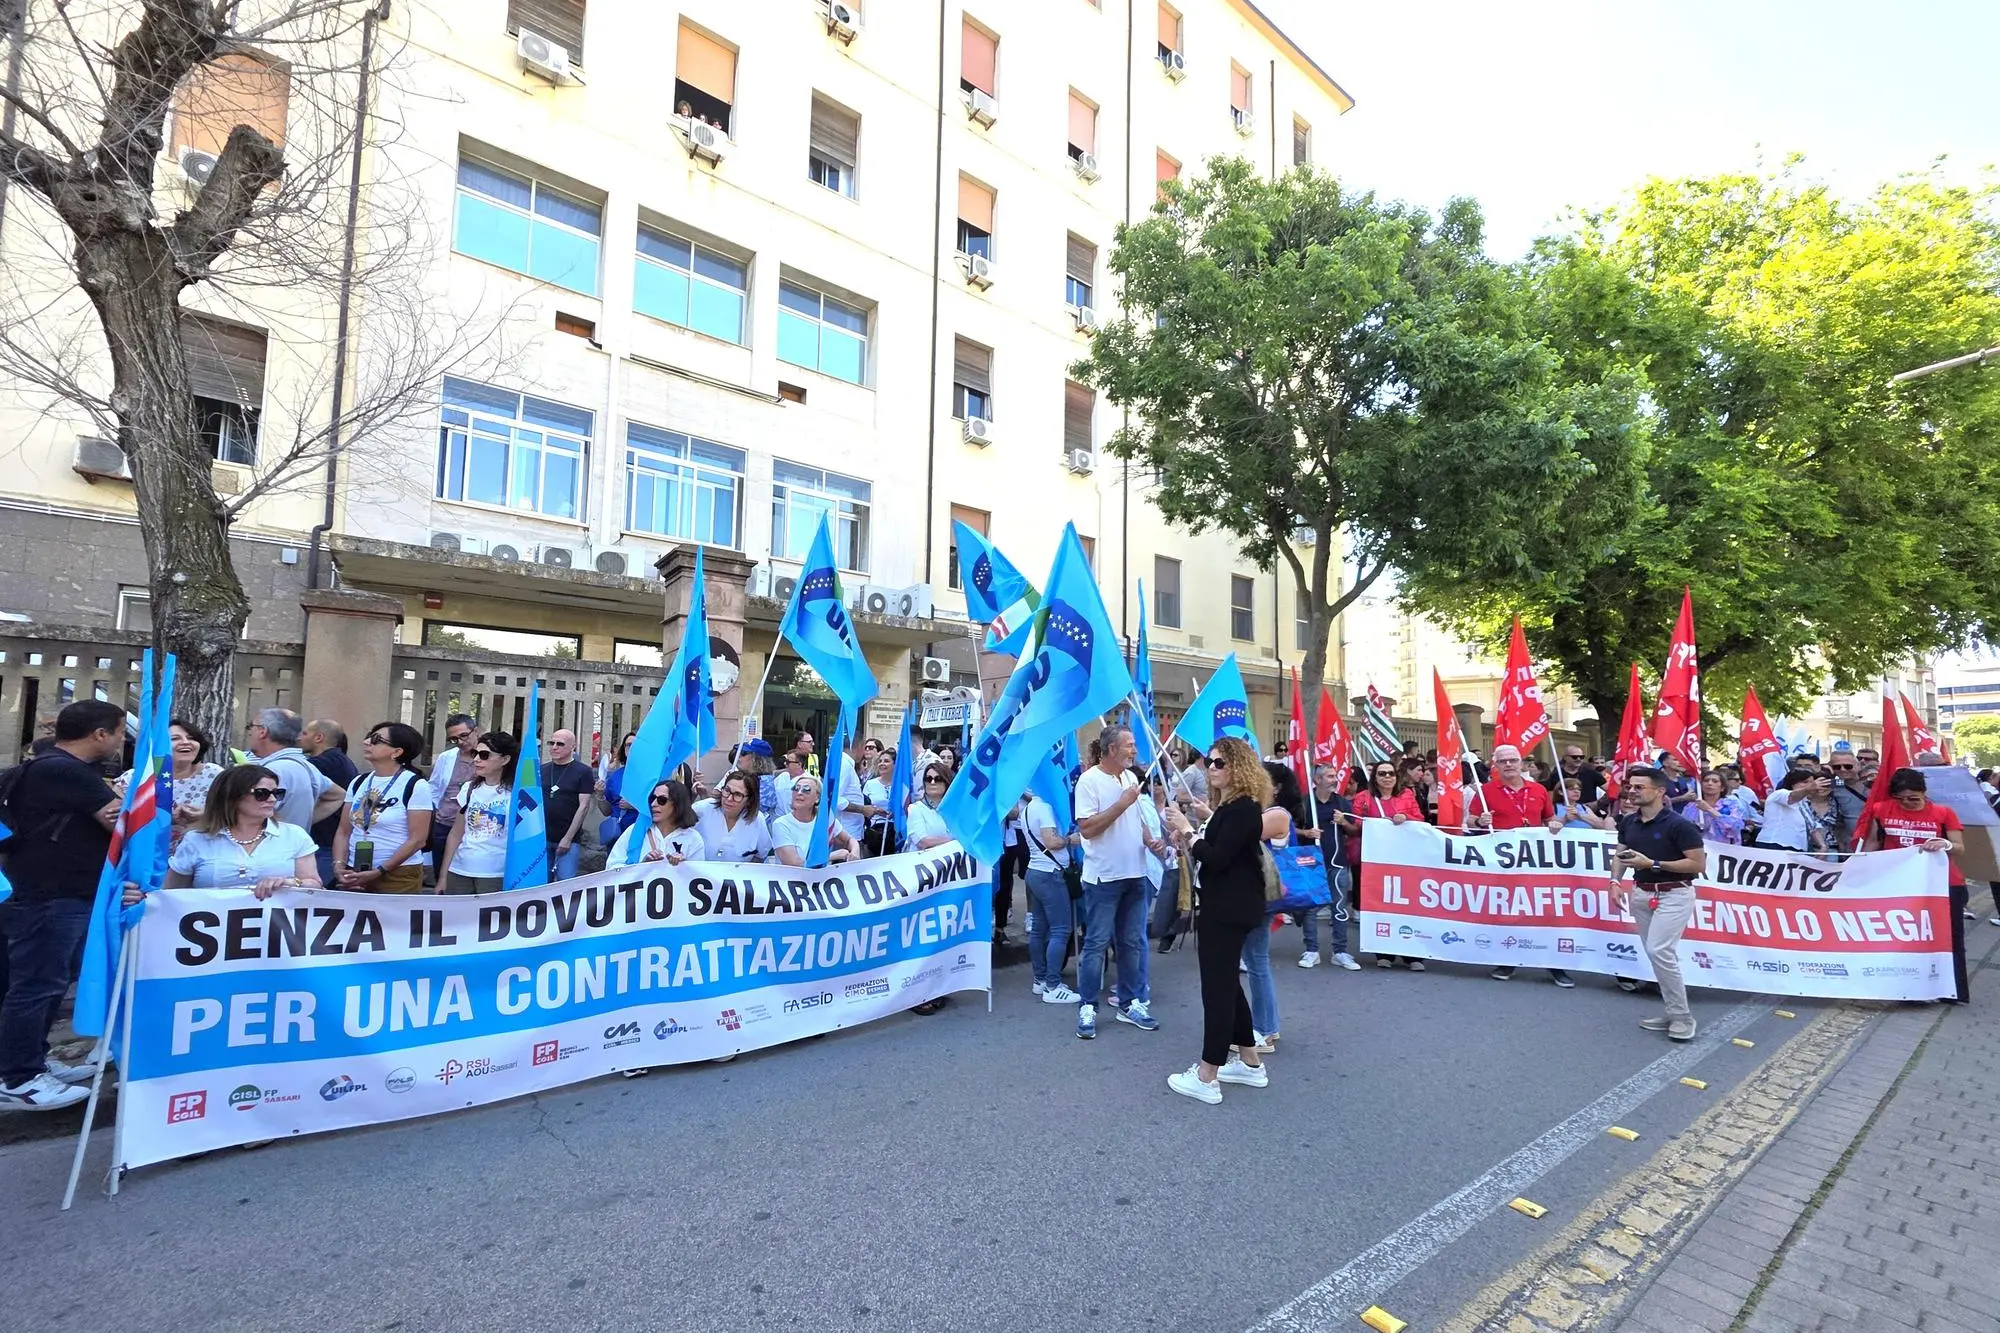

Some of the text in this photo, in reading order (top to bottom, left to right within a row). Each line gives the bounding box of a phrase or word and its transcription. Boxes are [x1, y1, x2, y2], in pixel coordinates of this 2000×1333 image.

[1445, 837, 1486, 867] LA
[1717, 854, 1843, 892] DIRITTO
[175, 851, 976, 966] SENZA IL DOVUTO SALARIO DA ANNI
[1383, 875, 1409, 905] IL
[1775, 908, 1822, 941] LO
[1829, 909, 1934, 942] NEGA
[171, 899, 976, 1056] PER UNA CONTRATTAZIONE VERA
[845, 977, 888, 991] FEDERAZIONE
[537, 1044, 556, 1057] FP
[466, 1057, 490, 1070] RSU
[466, 1060, 518, 1078] AOU Sassari
[232, 1090, 260, 1101] CISL
[264, 1089, 278, 1097] FP
[331, 1083, 367, 1095] UILFPL
[173, 1095, 202, 1113] FP
[264, 1094, 300, 1103] SASSARI
[172, 1111, 201, 1121] CGIL
